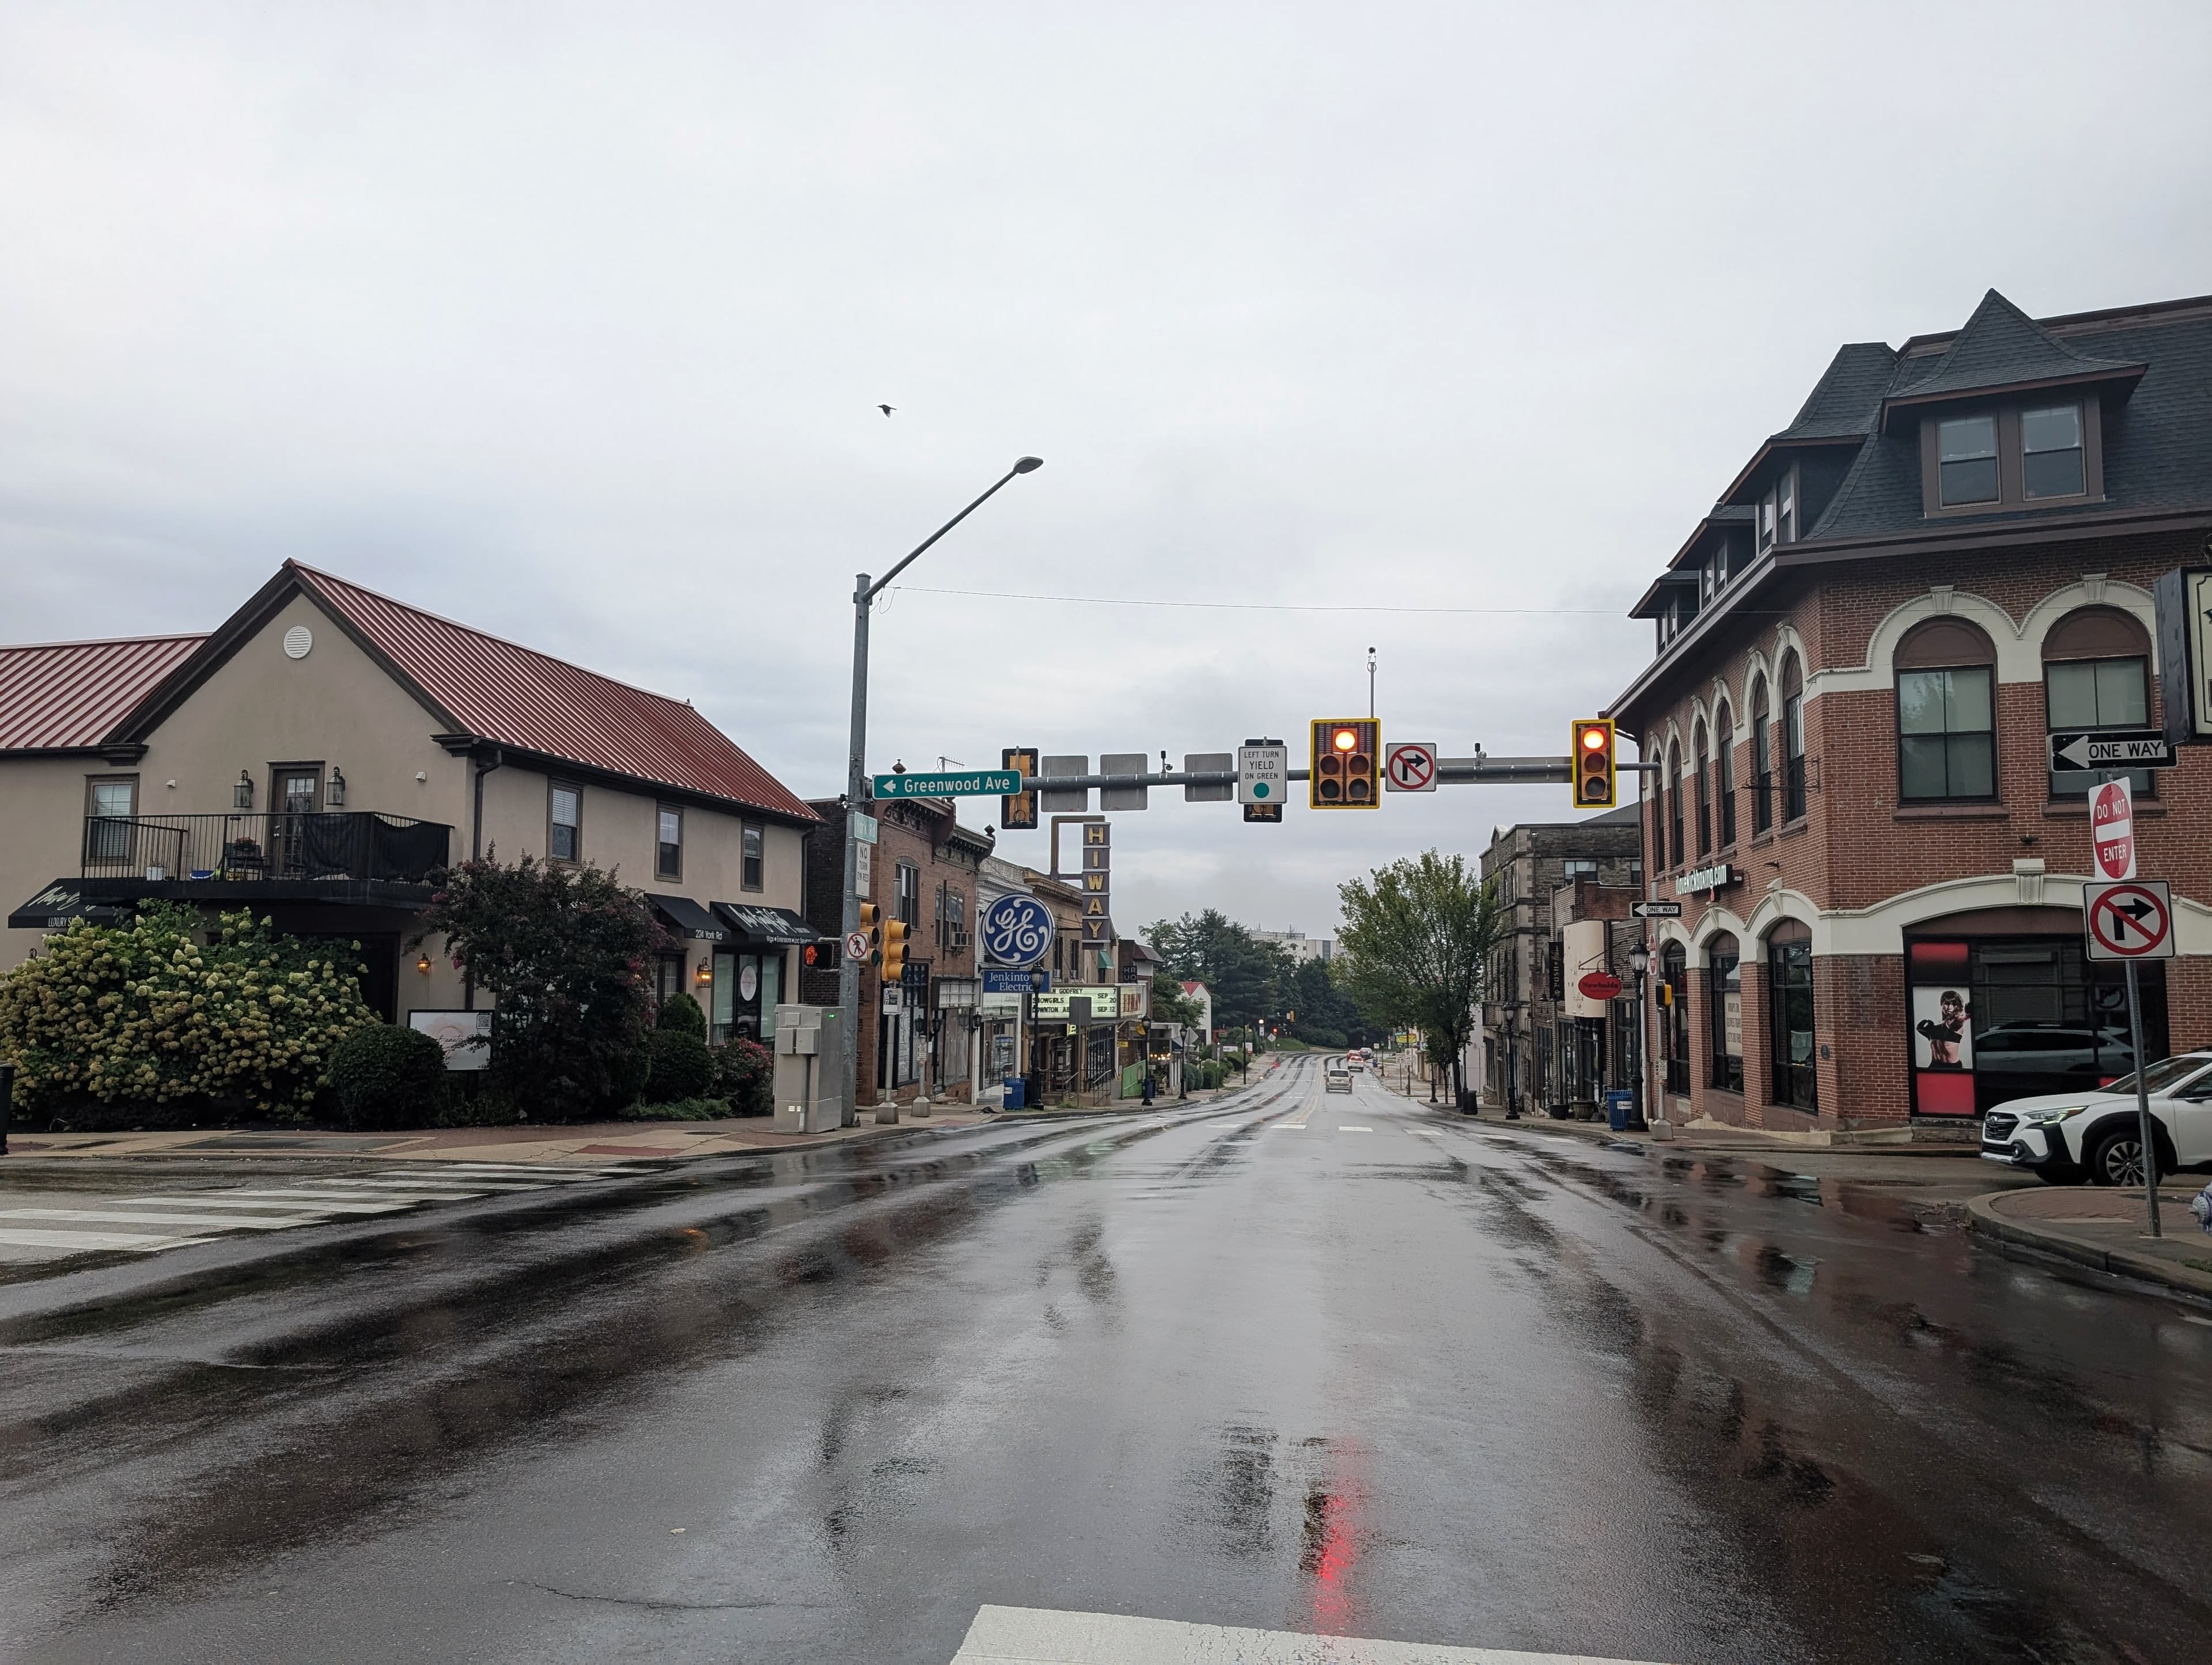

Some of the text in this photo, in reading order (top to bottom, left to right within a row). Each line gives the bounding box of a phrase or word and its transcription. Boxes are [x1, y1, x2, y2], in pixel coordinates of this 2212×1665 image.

[2089, 742, 2162, 758] ONE WAY
[1249, 761, 1274, 769] YIELD
[904, 776, 1010, 793] Greenwood Ave
[2097, 799, 2125, 820] DO NOT
[857, 819, 876, 838] York Rd
[860, 845, 868, 859] NO
[2104, 844, 2127, 862] ENTER
[859, 860, 868, 871] TURN
[857, 872, 862, 881] ON
[1087, 827, 1104, 939] HIWAY
[48, 917, 67, 927] LUXURY
[695, 929, 722, 940] 224 York Rd
[989, 972, 1035, 983] Jenkinto
[999, 982, 1034, 991] Electric
